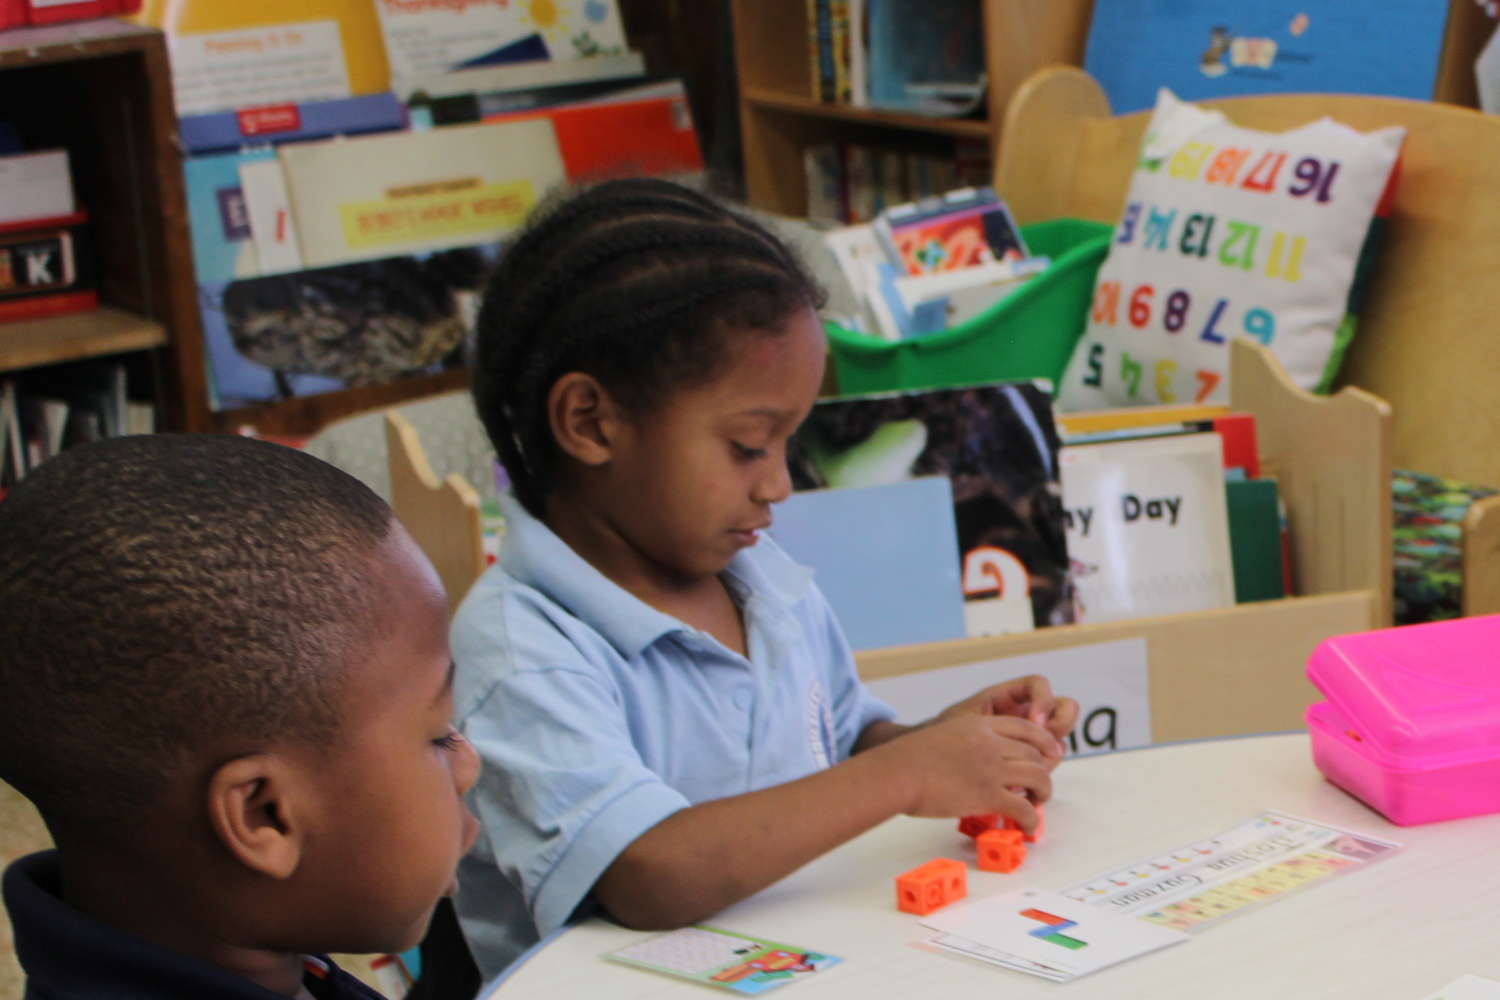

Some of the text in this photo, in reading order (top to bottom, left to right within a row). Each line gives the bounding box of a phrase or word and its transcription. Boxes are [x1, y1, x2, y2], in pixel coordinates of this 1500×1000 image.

[1168, 141, 1216, 182] 19
[1205, 148, 1253, 186] 18
[1240, 151, 1287, 194] 17
[1288, 156, 1340, 204] 16
[1142, 205, 1178, 250] 14
[1179, 213, 1217, 258] 13
[1218, 219, 1262, 271] 12
[1265, 231, 1307, 284] 11
[1092, 281, 1276, 347] 6 7 8 9 10
[1083, 343, 1105, 389] 5
[1121, 351, 1143, 399] 4
[1154, 358, 1178, 404] 3
[1121, 495, 1183, 527] Day
[1110, 871, 1203, 908] Guzman
